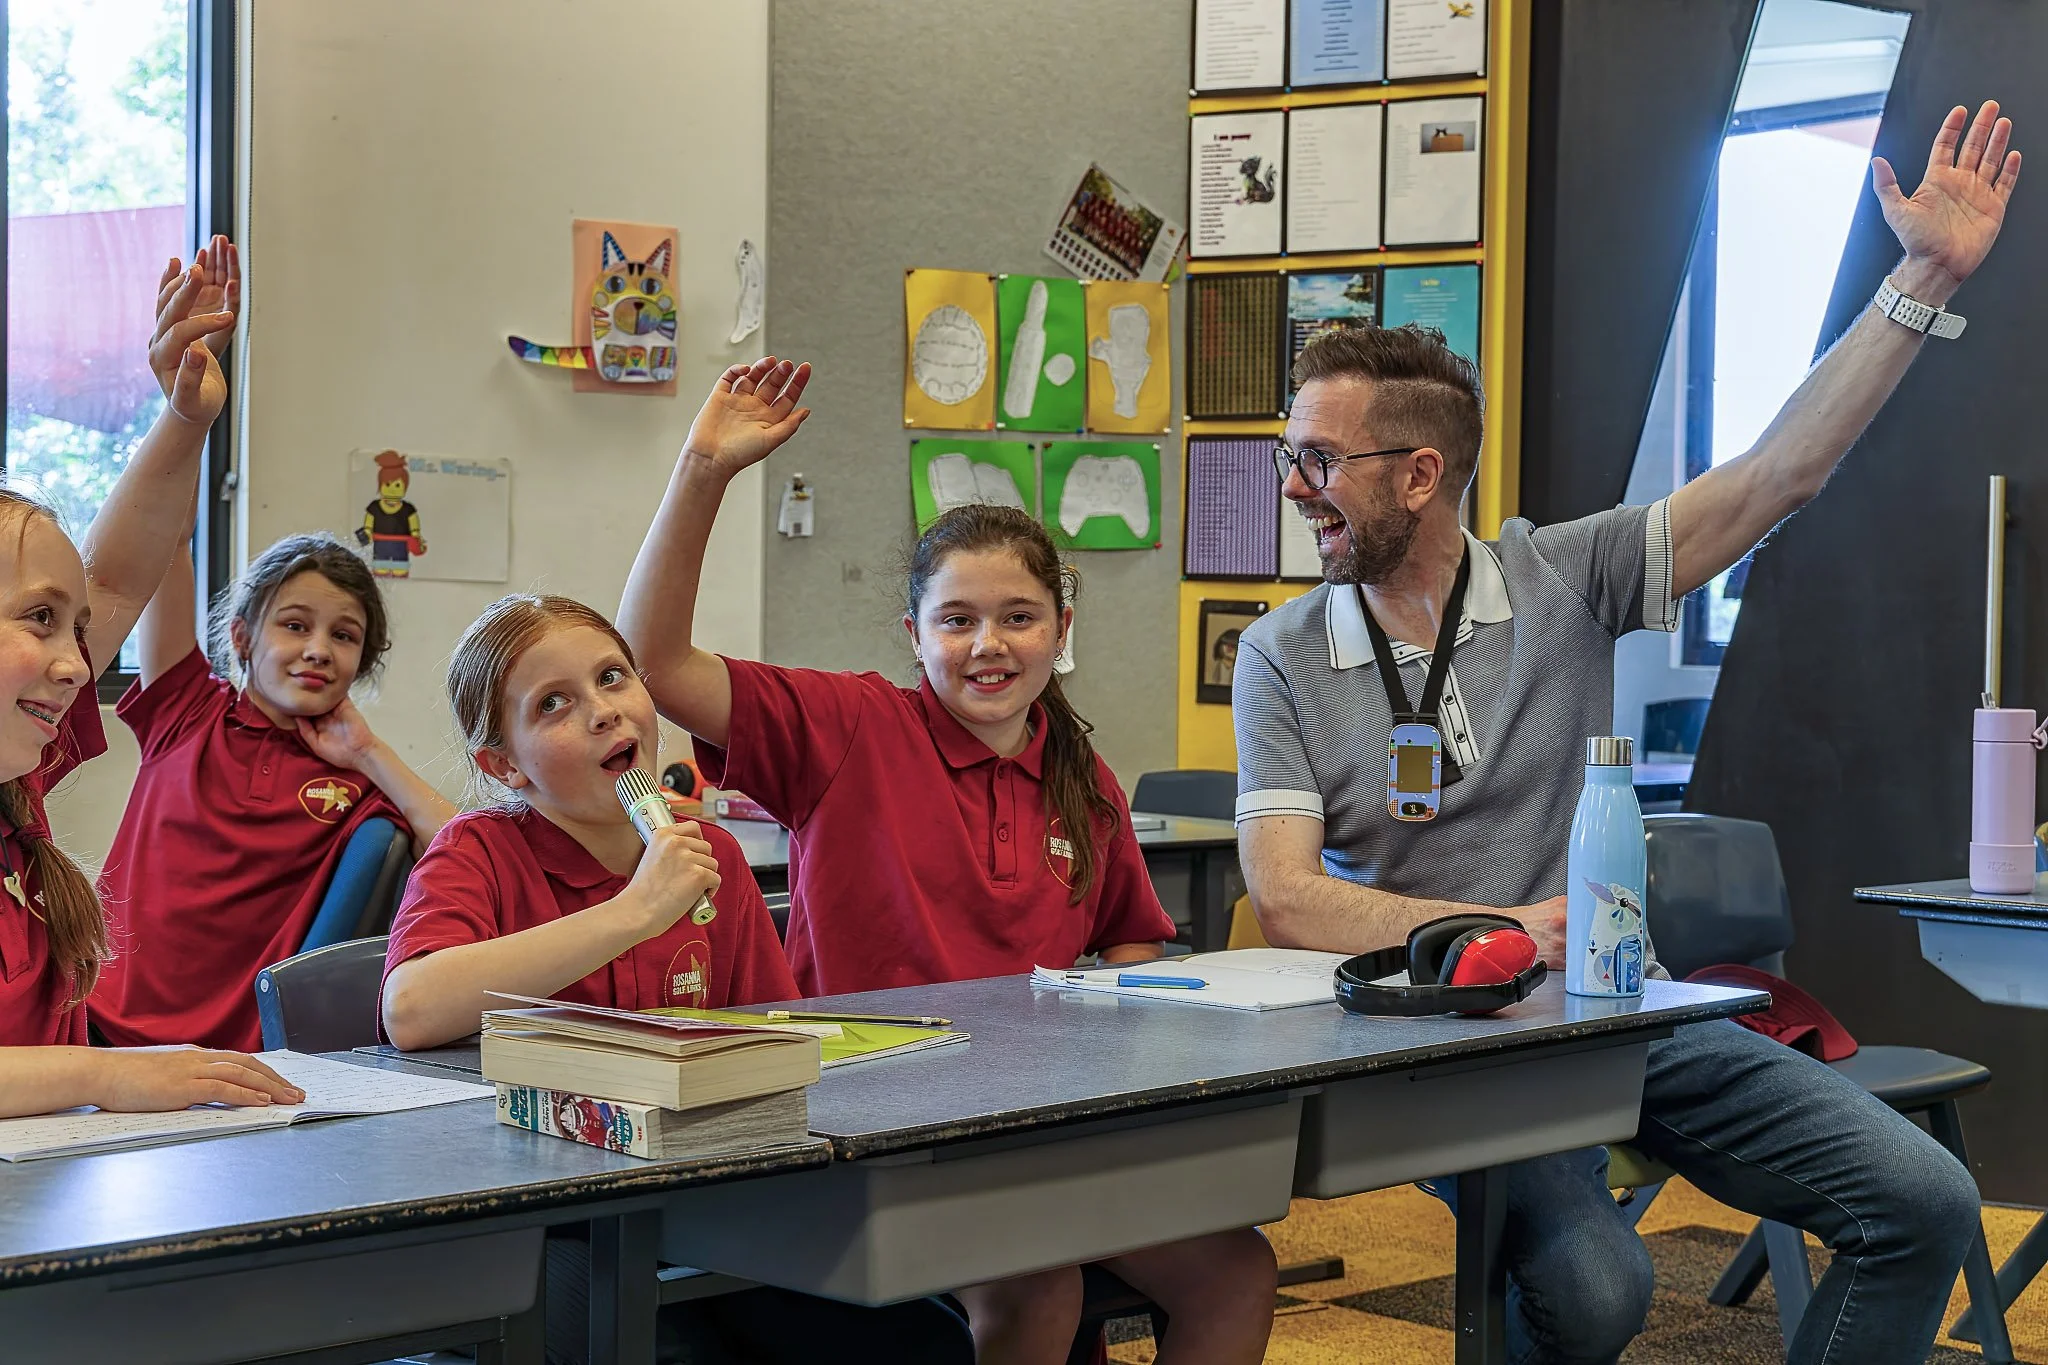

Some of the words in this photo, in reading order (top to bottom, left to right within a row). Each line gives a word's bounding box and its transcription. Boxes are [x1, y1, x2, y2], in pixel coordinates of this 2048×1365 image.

[673, 971, 700, 987] ROSANNA
[673, 985, 685, 995] GOLF
[687, 984, 701, 993] LINKS
[510, 1088, 520, 1120] ONE
[518, 1086, 529, 1127] PIECE
